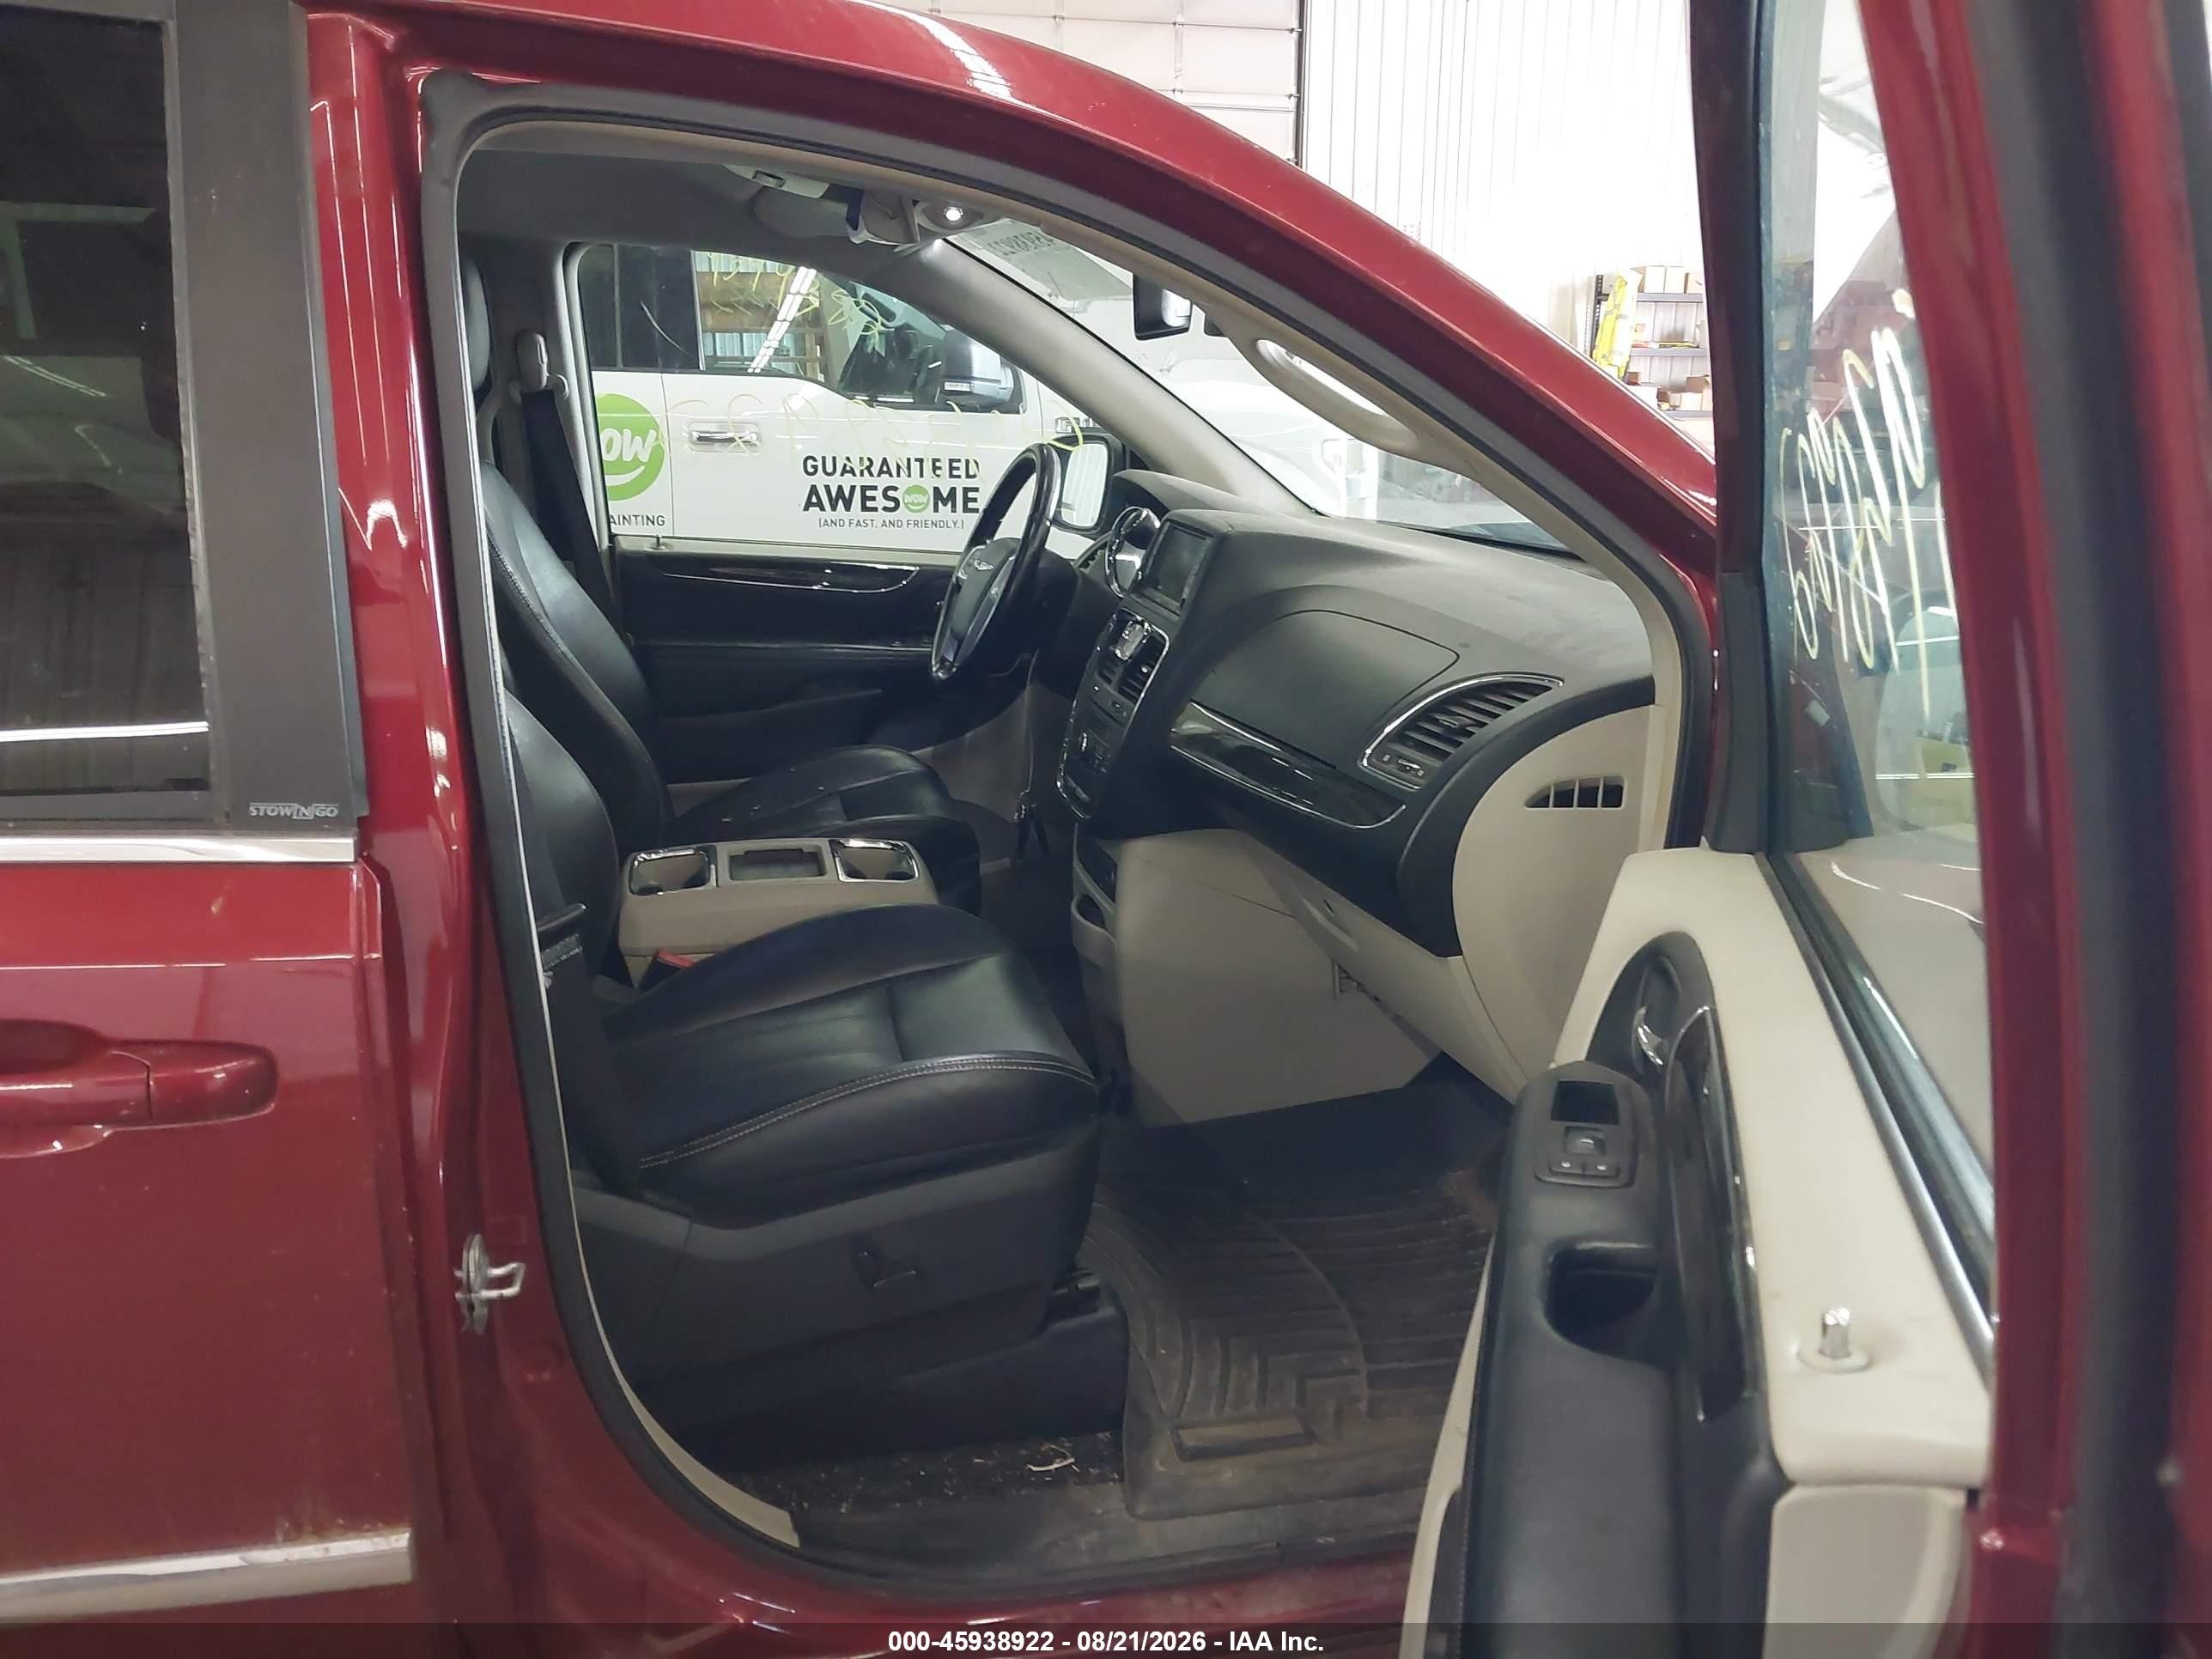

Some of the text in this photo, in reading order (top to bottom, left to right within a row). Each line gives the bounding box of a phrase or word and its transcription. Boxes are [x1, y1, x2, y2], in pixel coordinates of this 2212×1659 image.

[802, 455, 980, 479] GUARANTEED
[848, 519, 878, 528] FAST.
[881, 520, 902, 529] AND
